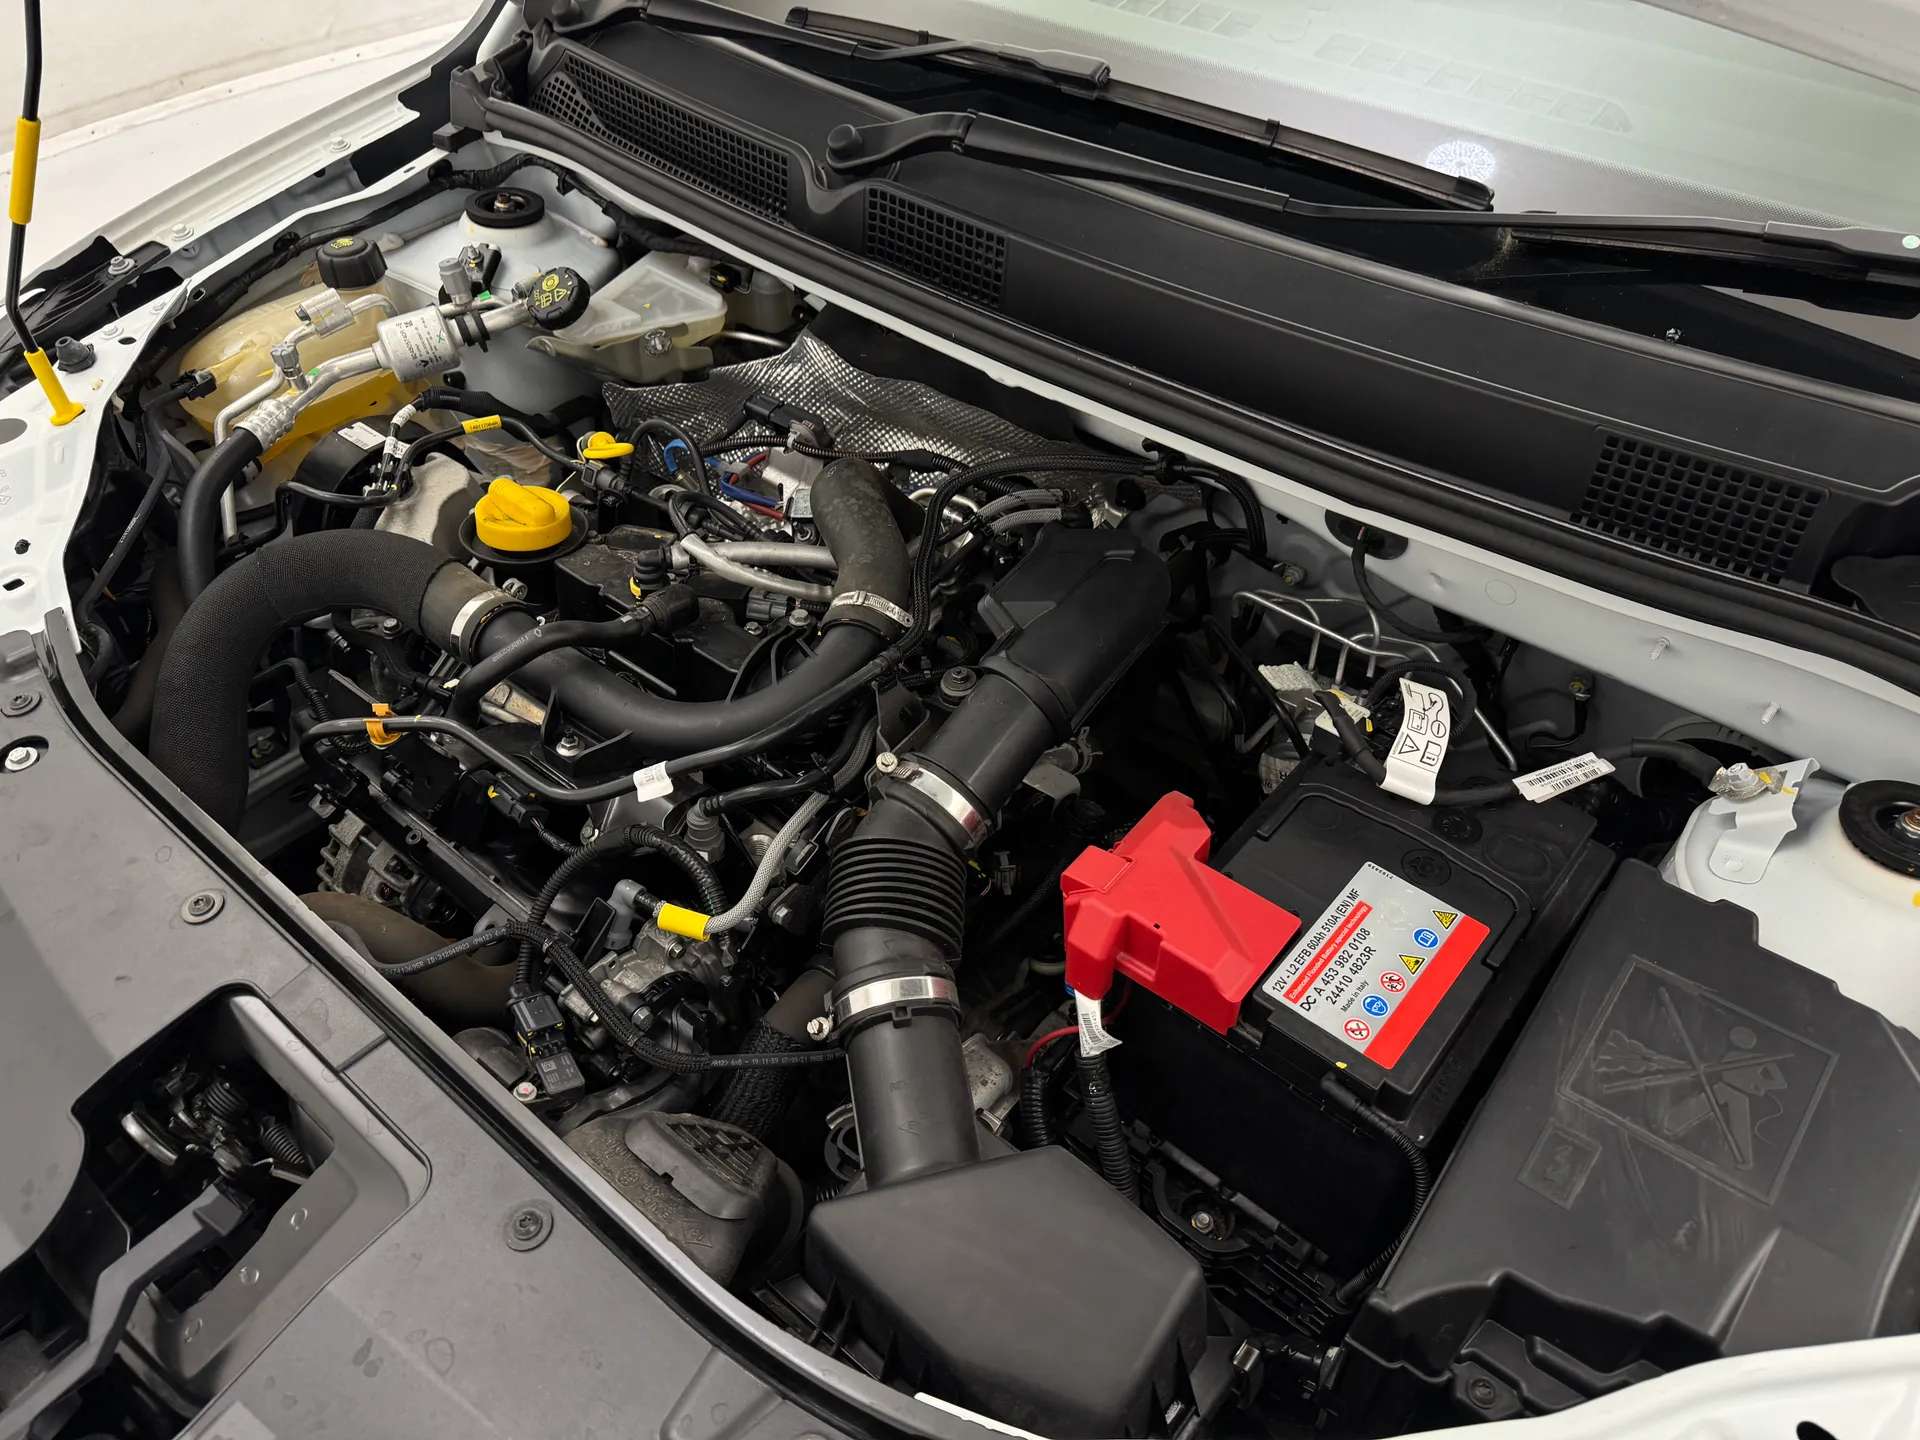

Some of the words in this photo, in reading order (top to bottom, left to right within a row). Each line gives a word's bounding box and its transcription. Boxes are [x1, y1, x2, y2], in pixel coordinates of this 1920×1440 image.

[1272, 976, 1287, 992] 12V
[1286, 963, 1300, 976] L2
[1294, 948, 1312, 966] EFB
[1307, 932, 1327, 950] 60Ah
[1321, 915, 1341, 932] 510A
[1335, 900, 1354, 917] (EN)
[1346, 888, 1359, 901] MF
[1299, 995, 1317, 1012] DC
[1313, 985, 1326, 997] A
[1321, 968, 1339, 986] 453
[1334, 949, 1353, 968] 982
[1348, 928, 1370, 950] 0108
[1326, 975, 1353, 1005] 24410
[1349, 946, 1376, 975] 4823R
[1340, 997, 1355, 1012] Made
[1356, 980, 1369, 992] Italy
